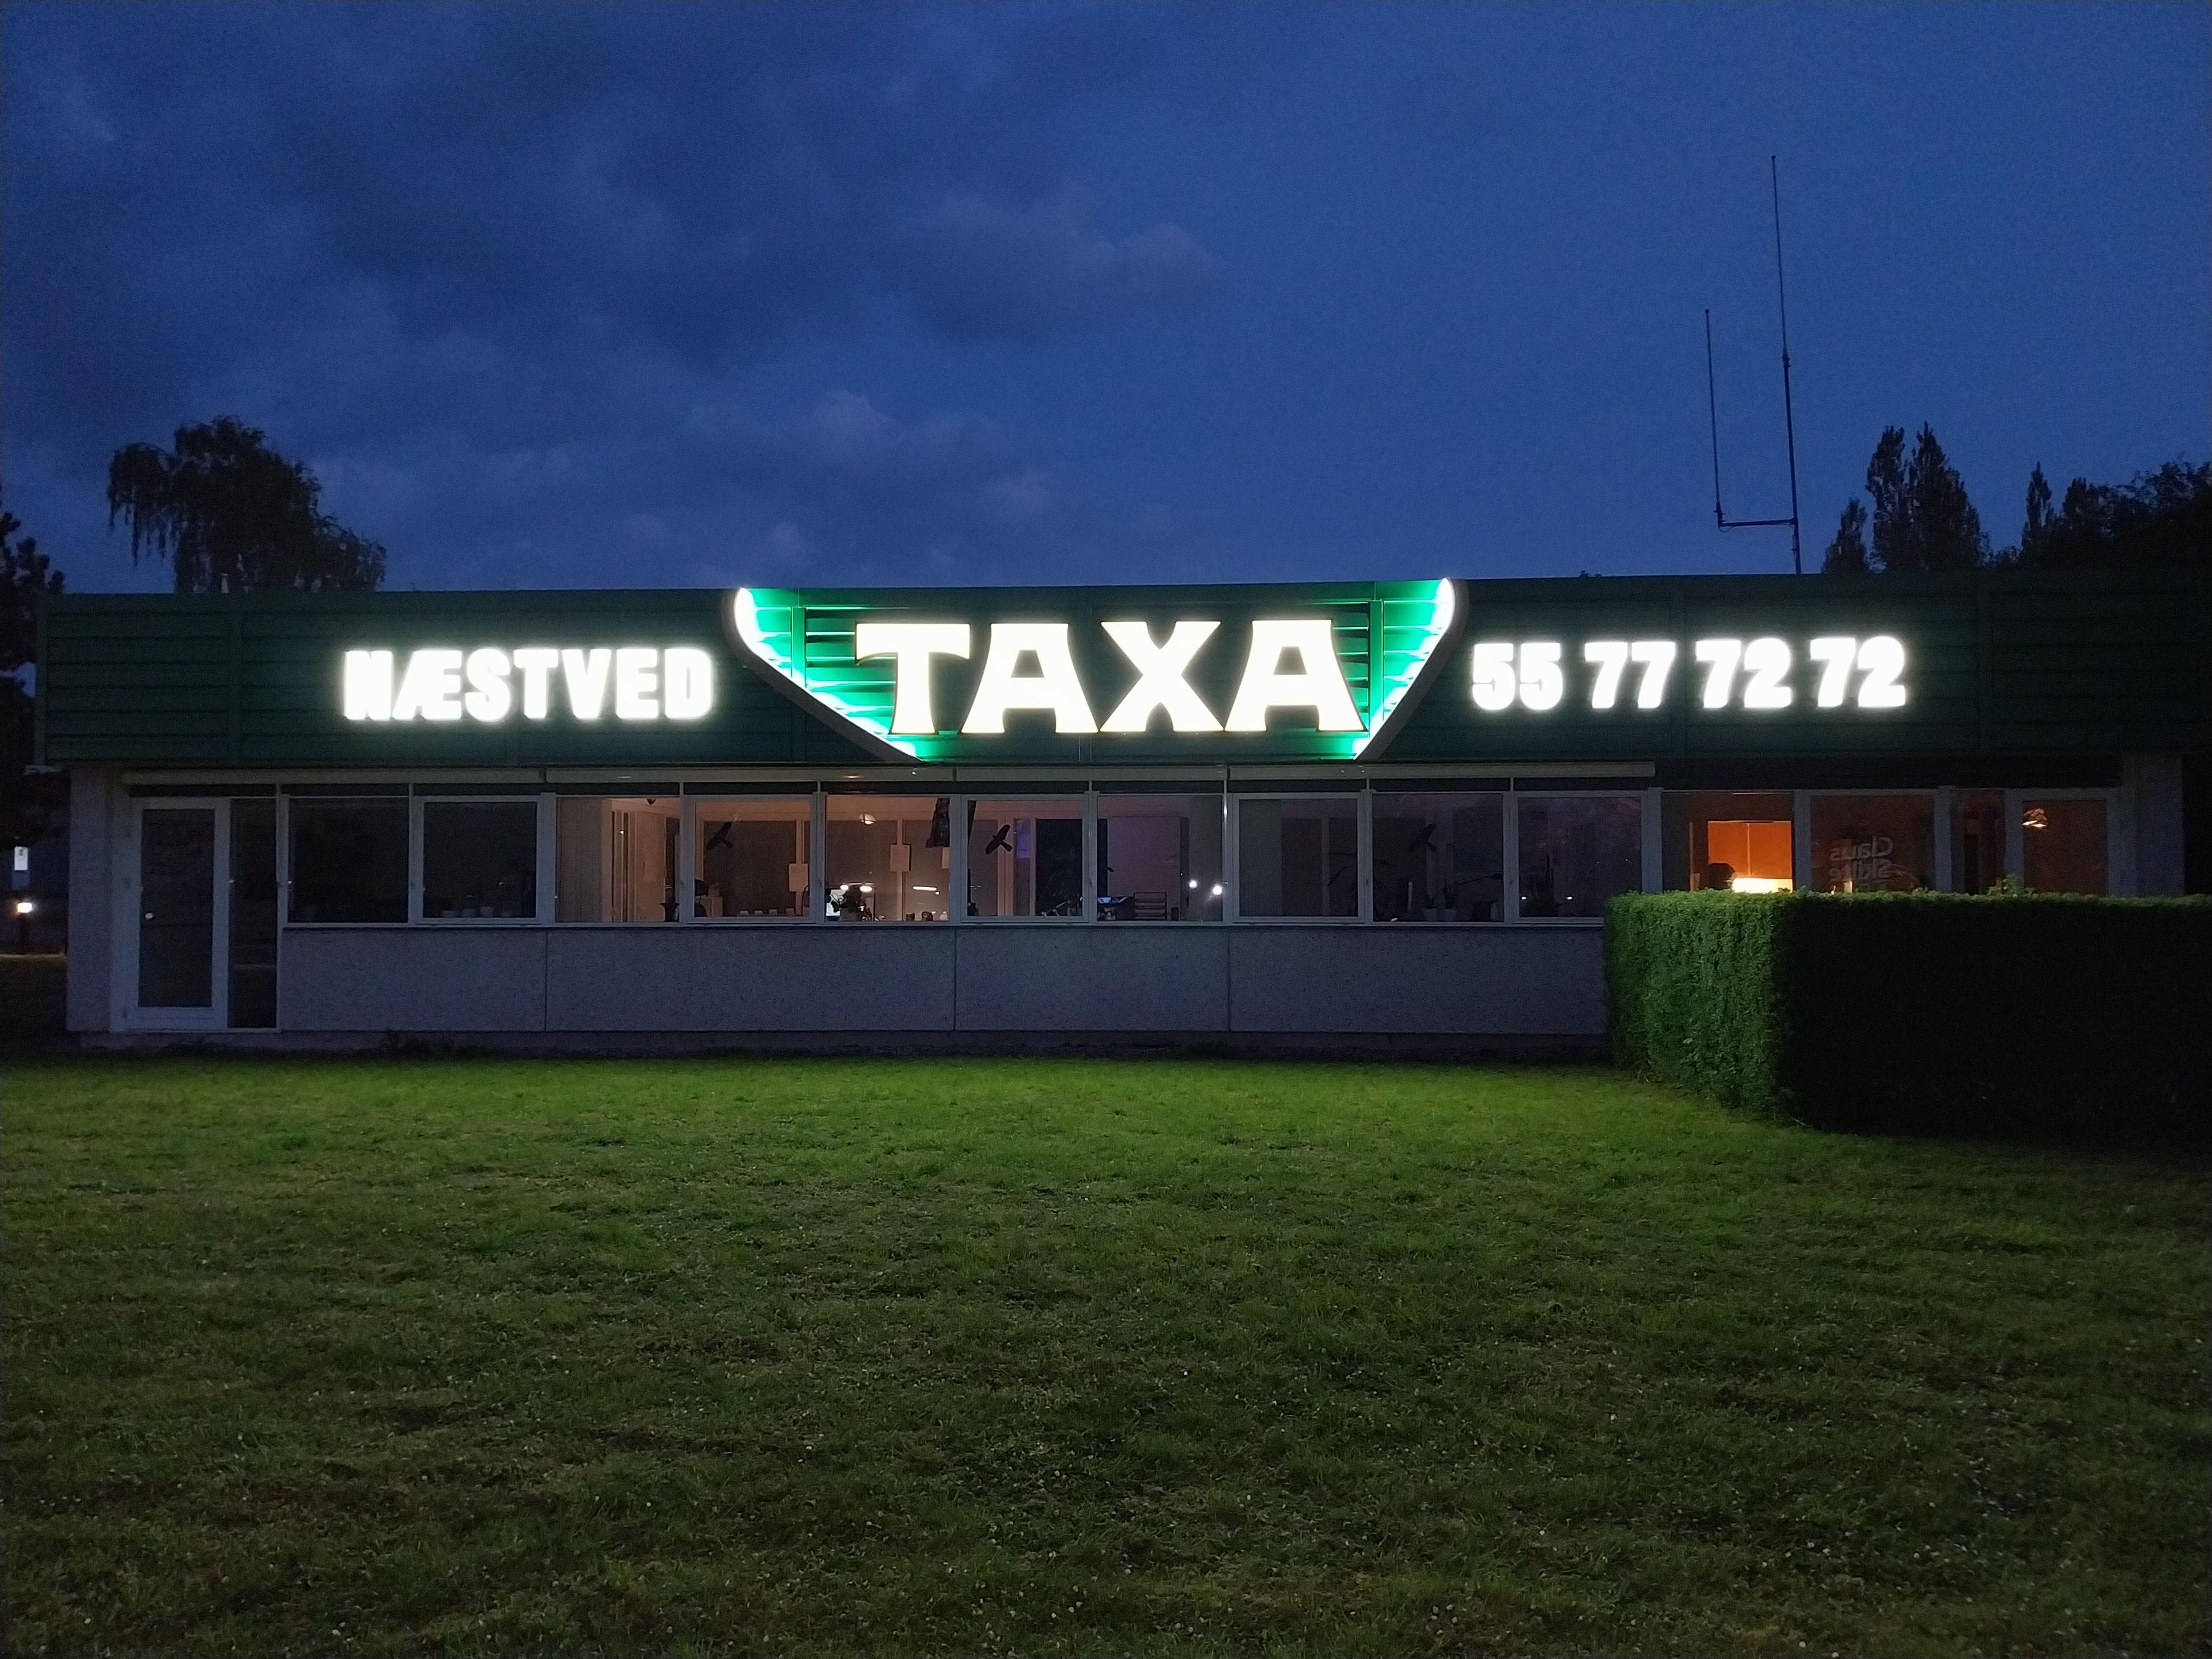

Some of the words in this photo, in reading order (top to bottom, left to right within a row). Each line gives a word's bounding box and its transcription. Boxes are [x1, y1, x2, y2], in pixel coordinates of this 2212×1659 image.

[344, 647, 713, 721] NÆSTVED
[857, 620, 1363, 733] TAXA
[1472, 642, 1563, 710] 55
[1585, 641, 1676, 709] 77
[1696, 638, 1791, 708] 72
[1810, 636, 1906, 707] 72
